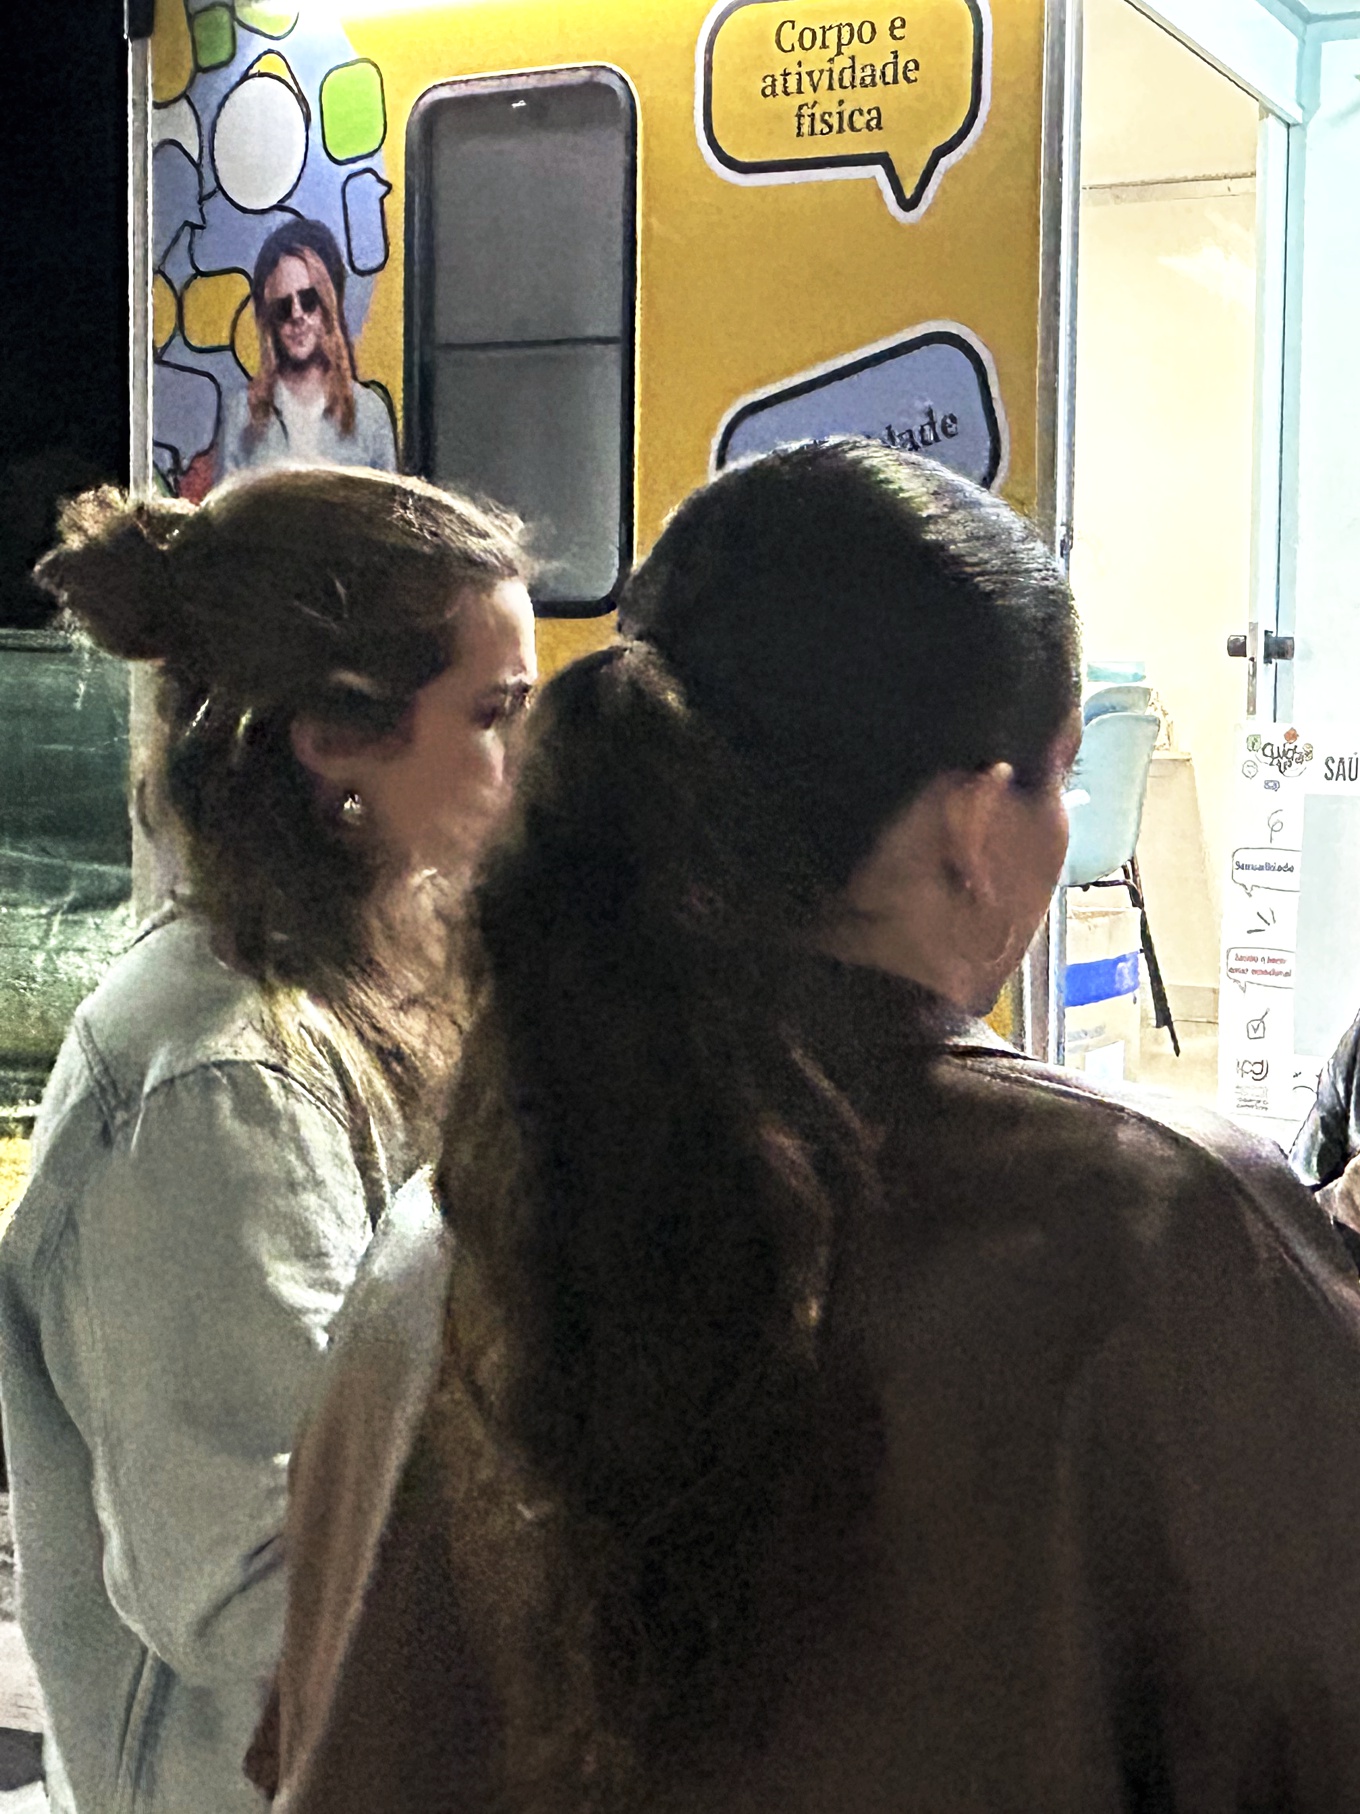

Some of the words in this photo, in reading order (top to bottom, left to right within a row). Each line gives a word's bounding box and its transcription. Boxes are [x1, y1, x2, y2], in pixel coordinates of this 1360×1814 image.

[775, 20, 877, 58] Corpo
[889, 16, 906, 41] e
[761, 51, 920, 98] atividade
[794, 100, 883, 138] física
